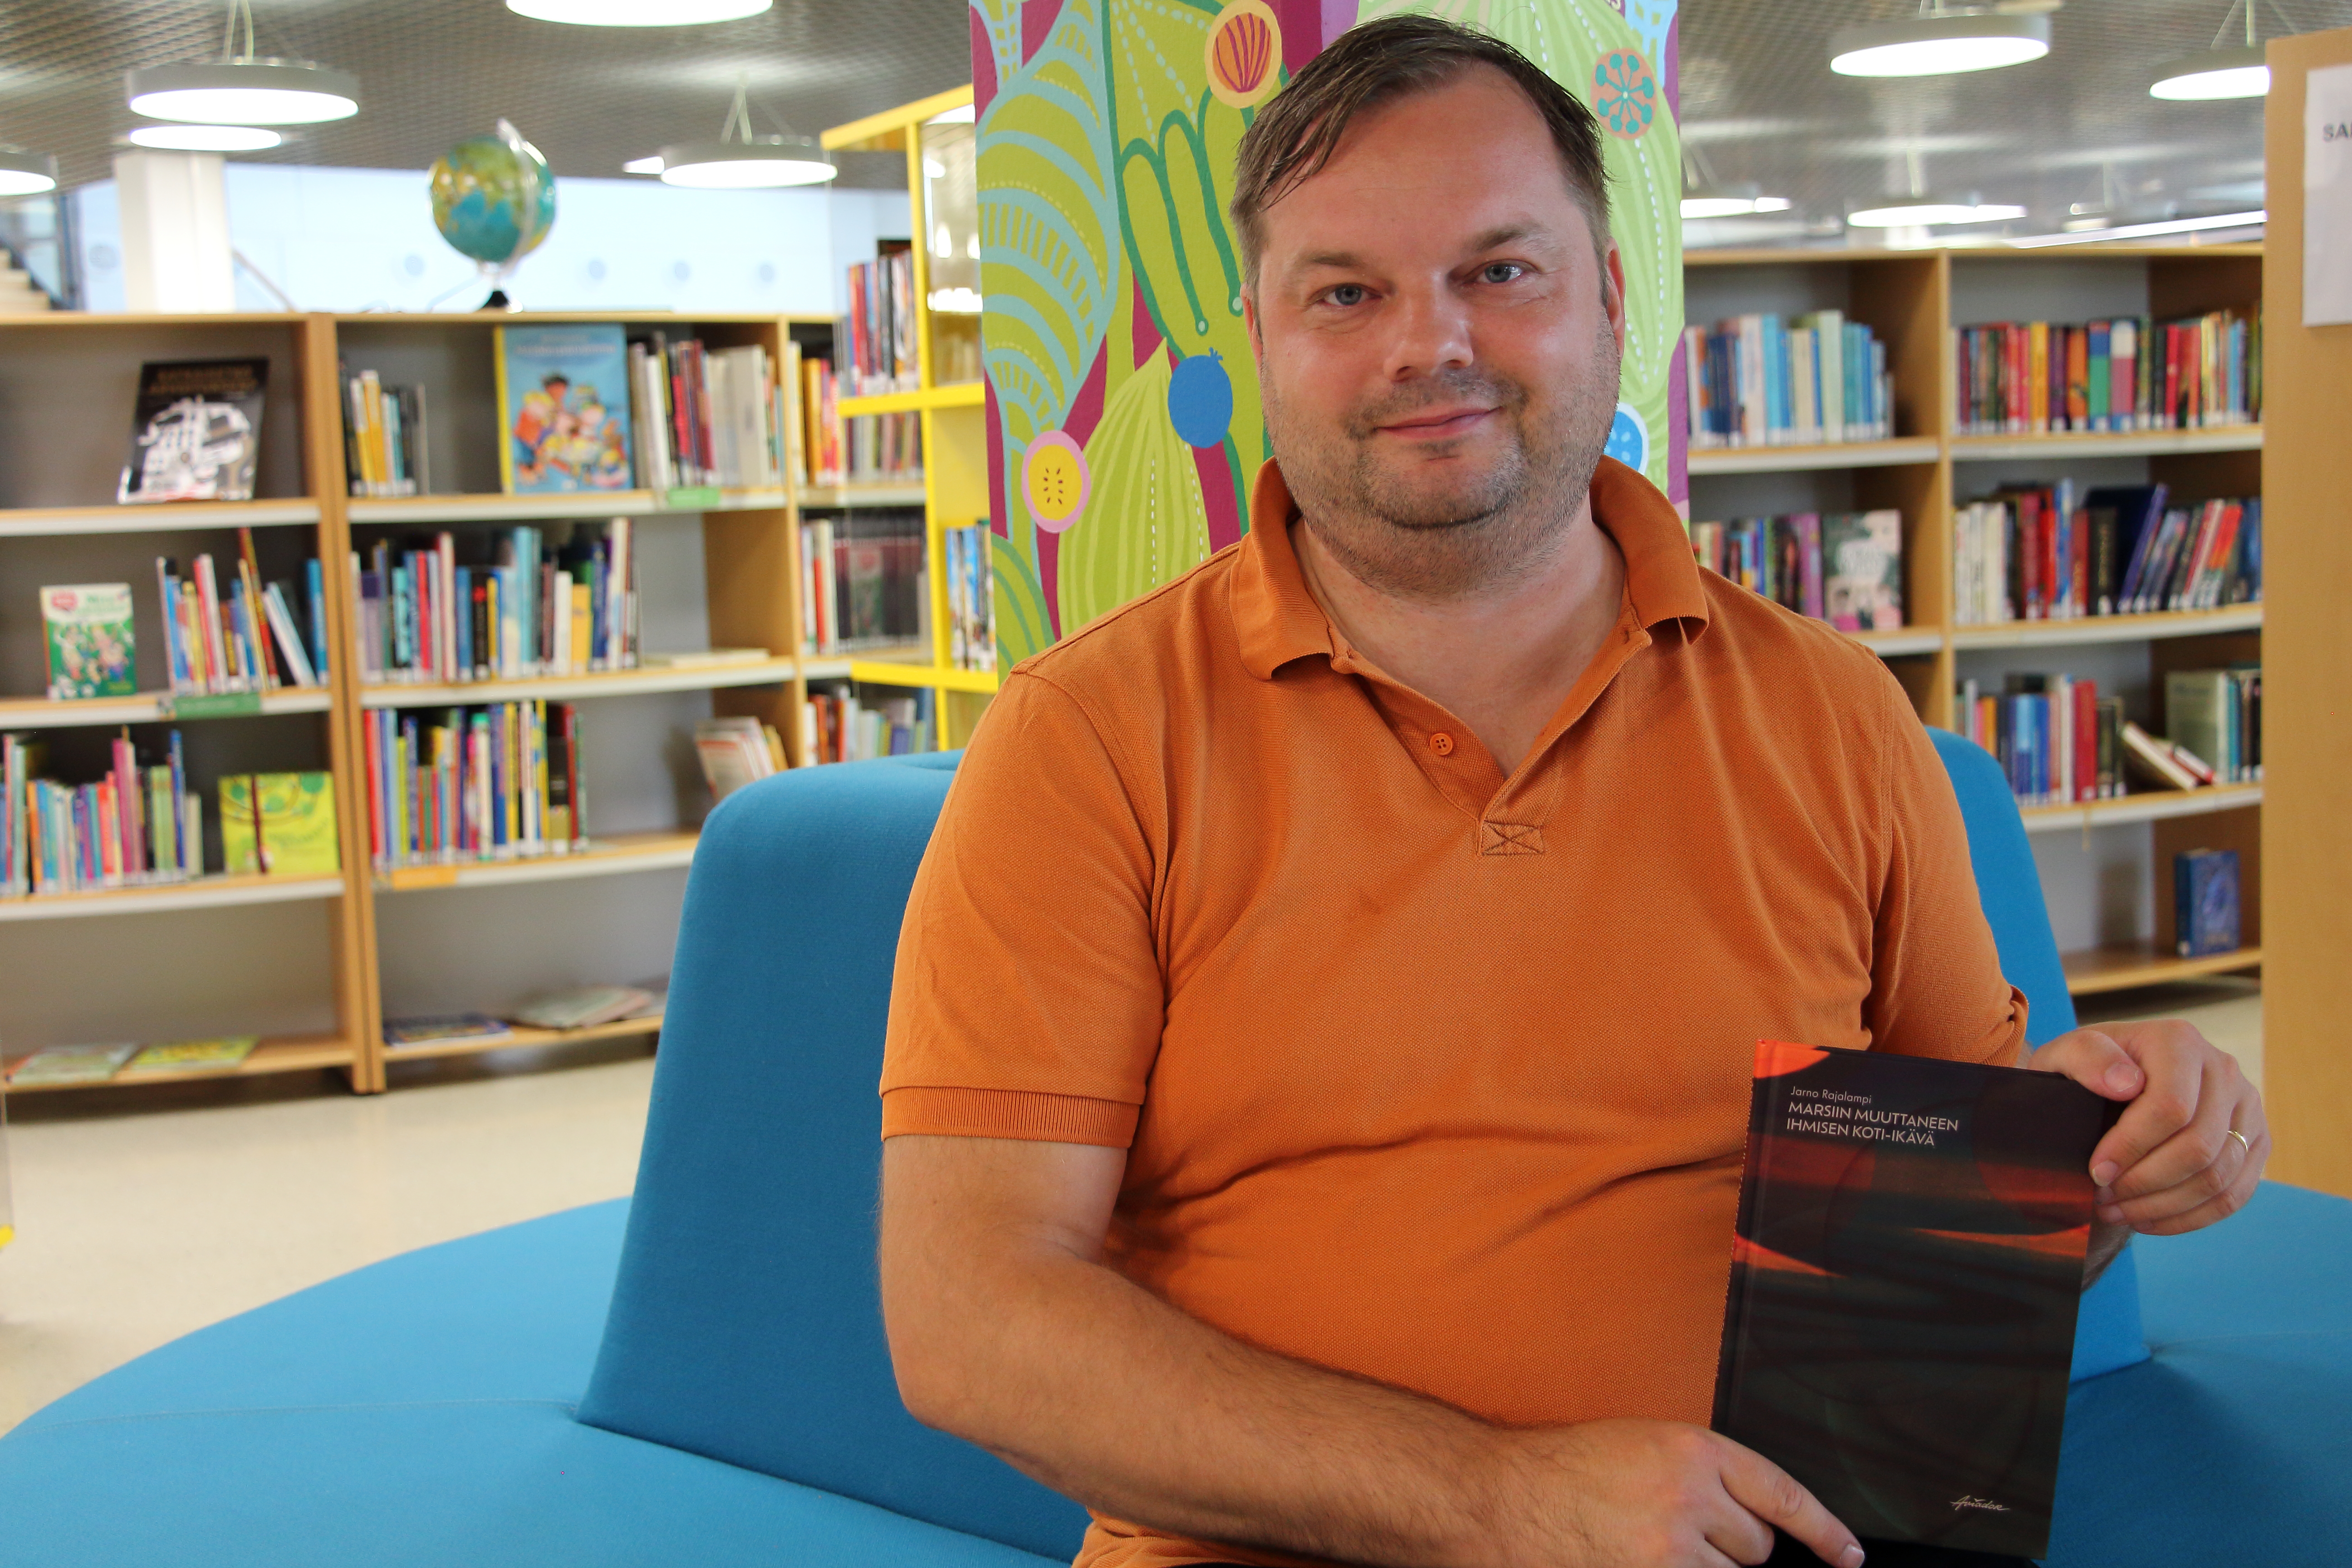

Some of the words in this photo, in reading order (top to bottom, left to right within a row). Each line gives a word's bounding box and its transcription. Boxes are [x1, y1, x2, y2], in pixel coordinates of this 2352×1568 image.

[2323, 122, 2352, 142] SA
[1790, 1086, 1819, 1098] Jarno
[1822, 1089, 1872, 1106] Rajalampi
[1788, 1101, 1851, 1119] MARSIIN
[1854, 1109, 1959, 1131] MUUTTANEEN
[1786, 1117, 1849, 1136] IHMISEN
[1852, 1125, 1935, 1146] KOTI-IKÄVÄ
